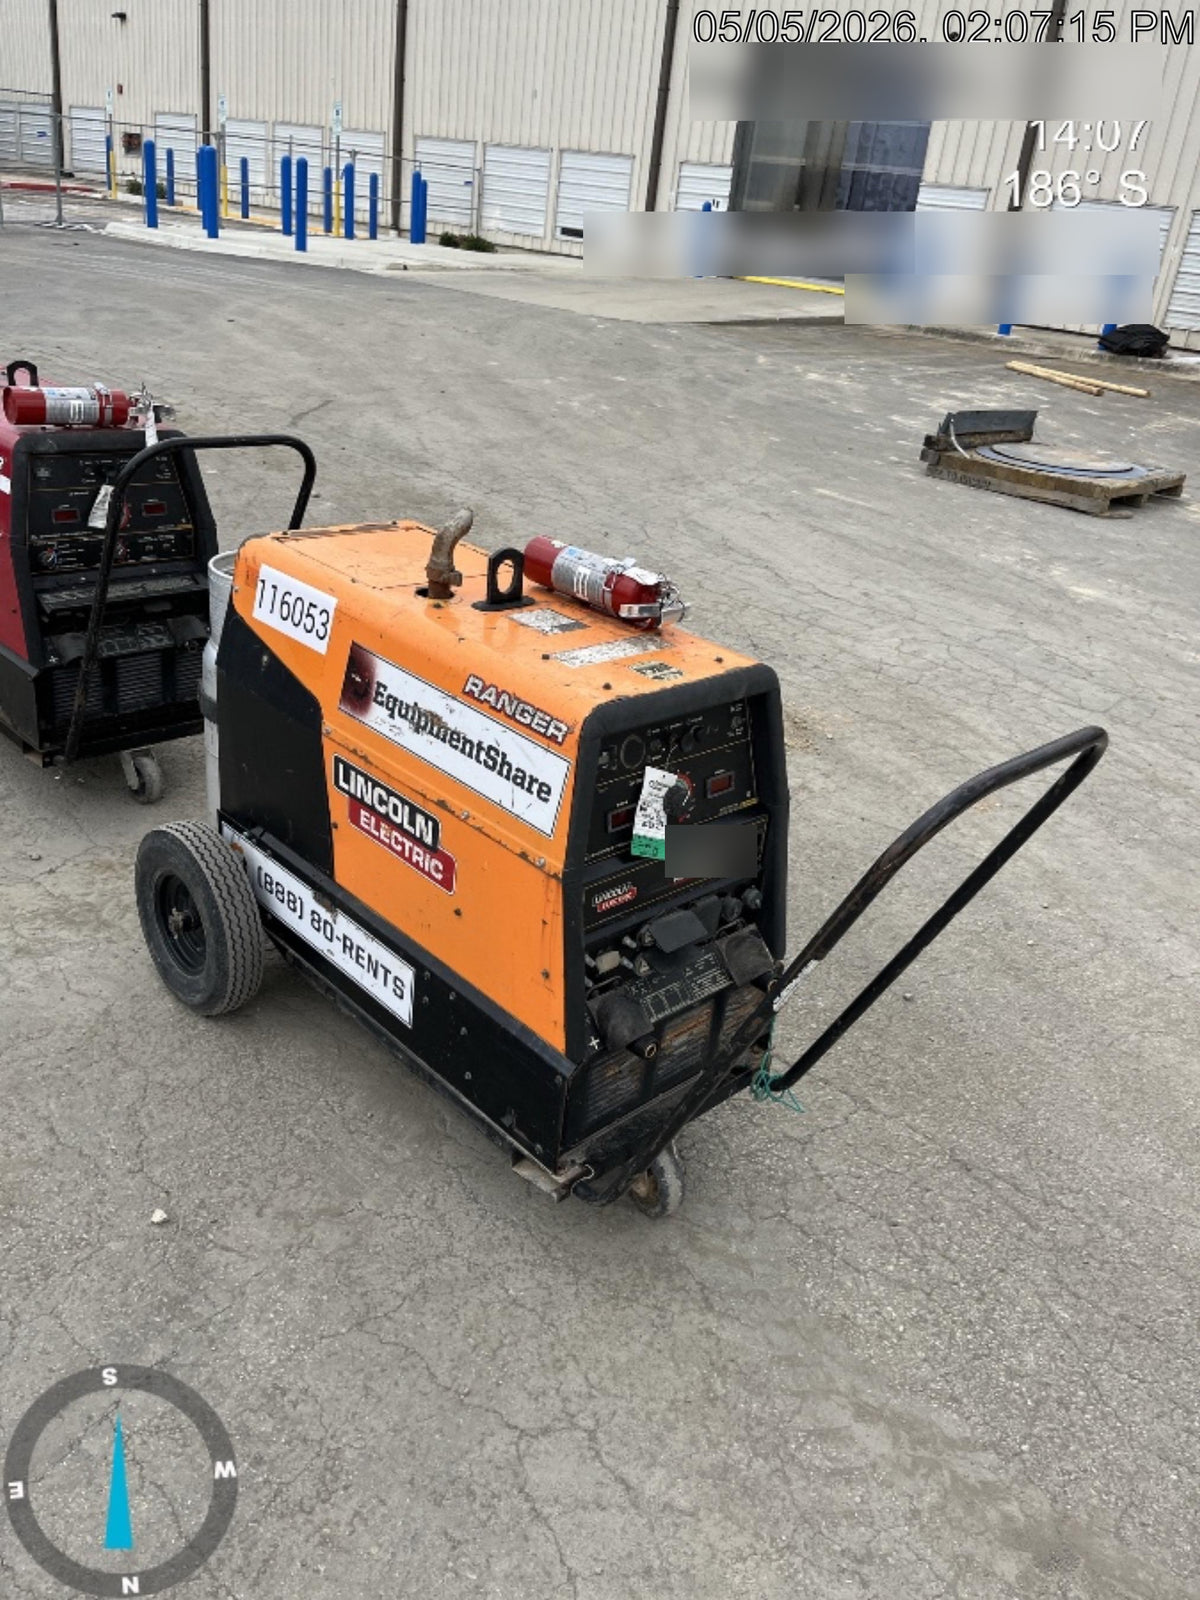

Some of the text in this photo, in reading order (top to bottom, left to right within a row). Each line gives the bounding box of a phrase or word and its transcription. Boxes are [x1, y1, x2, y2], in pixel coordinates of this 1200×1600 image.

[257, 578, 330, 641] 116053
[373, 679, 553, 803] EquipmentShare
[462, 674, 570, 746] RANGER
[338, 762, 434, 845] LINCOLN
[359, 809, 443, 880] ELECTRIC
[257, 865, 406, 1000] (888) 80-RENTS
